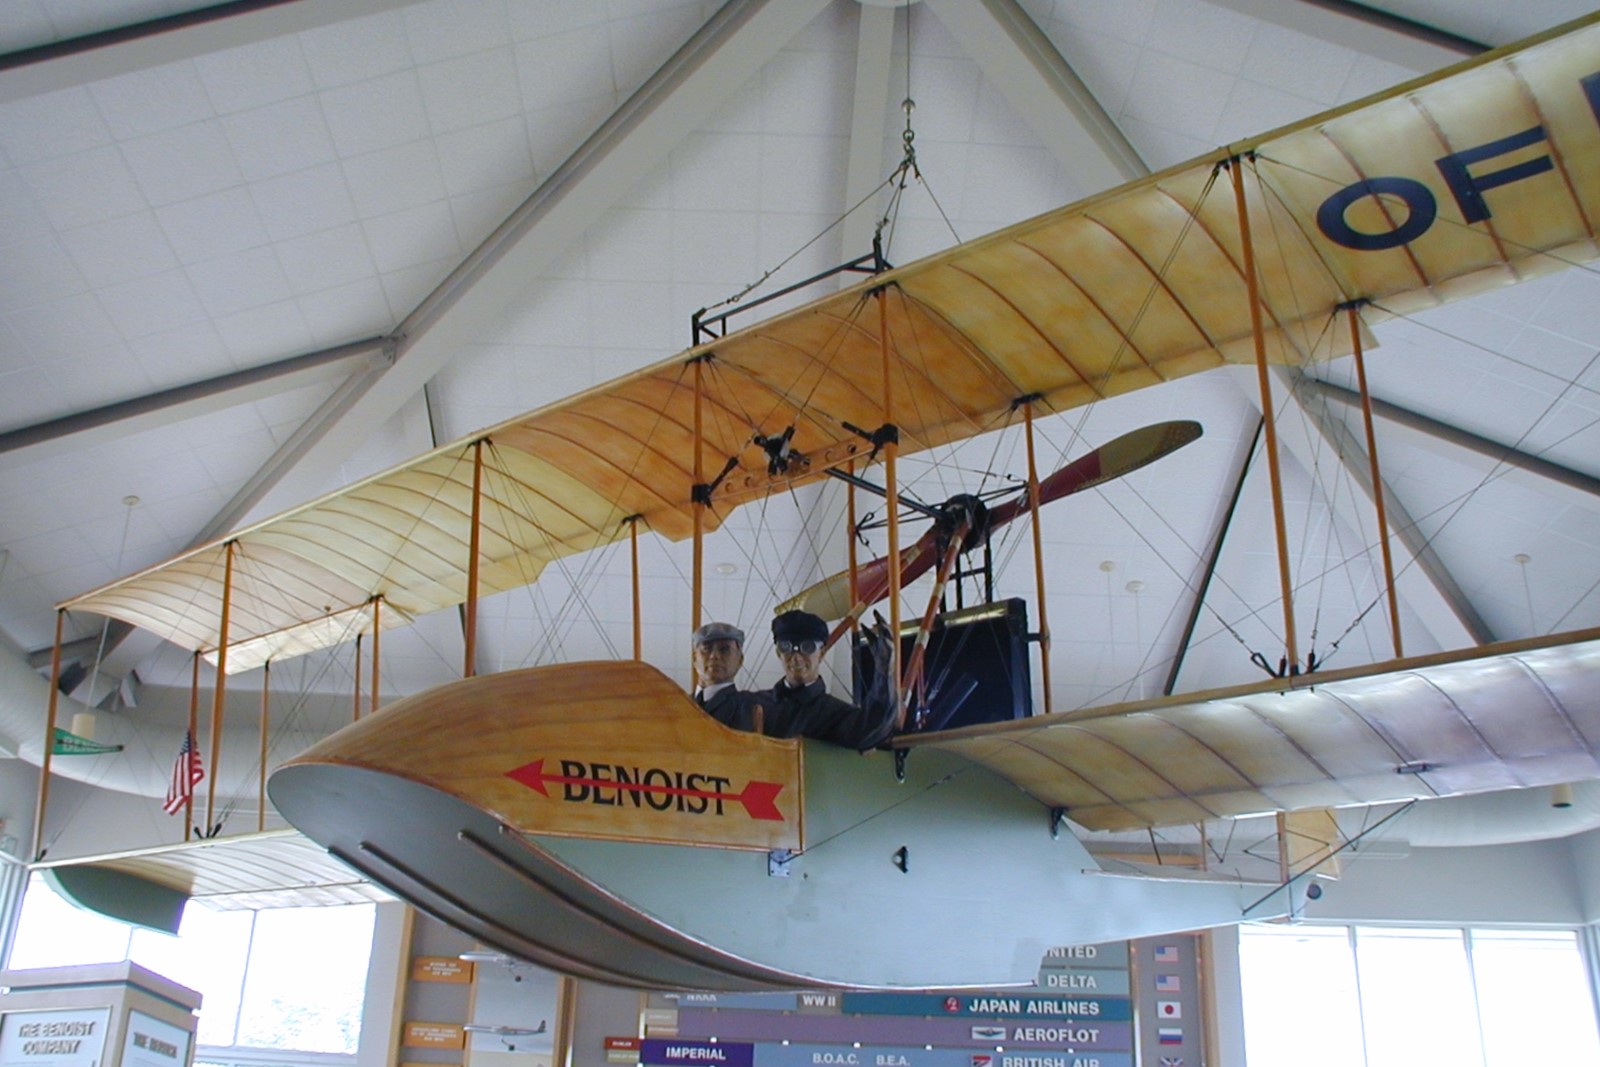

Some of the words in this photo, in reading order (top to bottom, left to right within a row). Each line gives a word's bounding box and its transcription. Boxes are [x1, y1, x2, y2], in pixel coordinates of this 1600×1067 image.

[1316, 125, 1554, 251] OF
[560, 760, 730, 815] BENOIST
[1045, 946, 1096, 958] NITED
[1047, 974, 1097, 988] DELTA
[802, 995, 825, 1007] WW
[969, 998, 1020, 1013] JAPAN
[1027, 1000, 1100, 1015] AIRLINES
[1014, 1027, 1099, 1042] AEROFLOT
[22, 1039, 81, 1056] COMPANY
[666, 1047, 726, 1060] IMPERIAL
[813, 1053, 859, 1065] B.O.A.C.
[876, 1055, 911, 1066] B.E.A.
[1002, 1057, 1065, 1067] BRITISH
